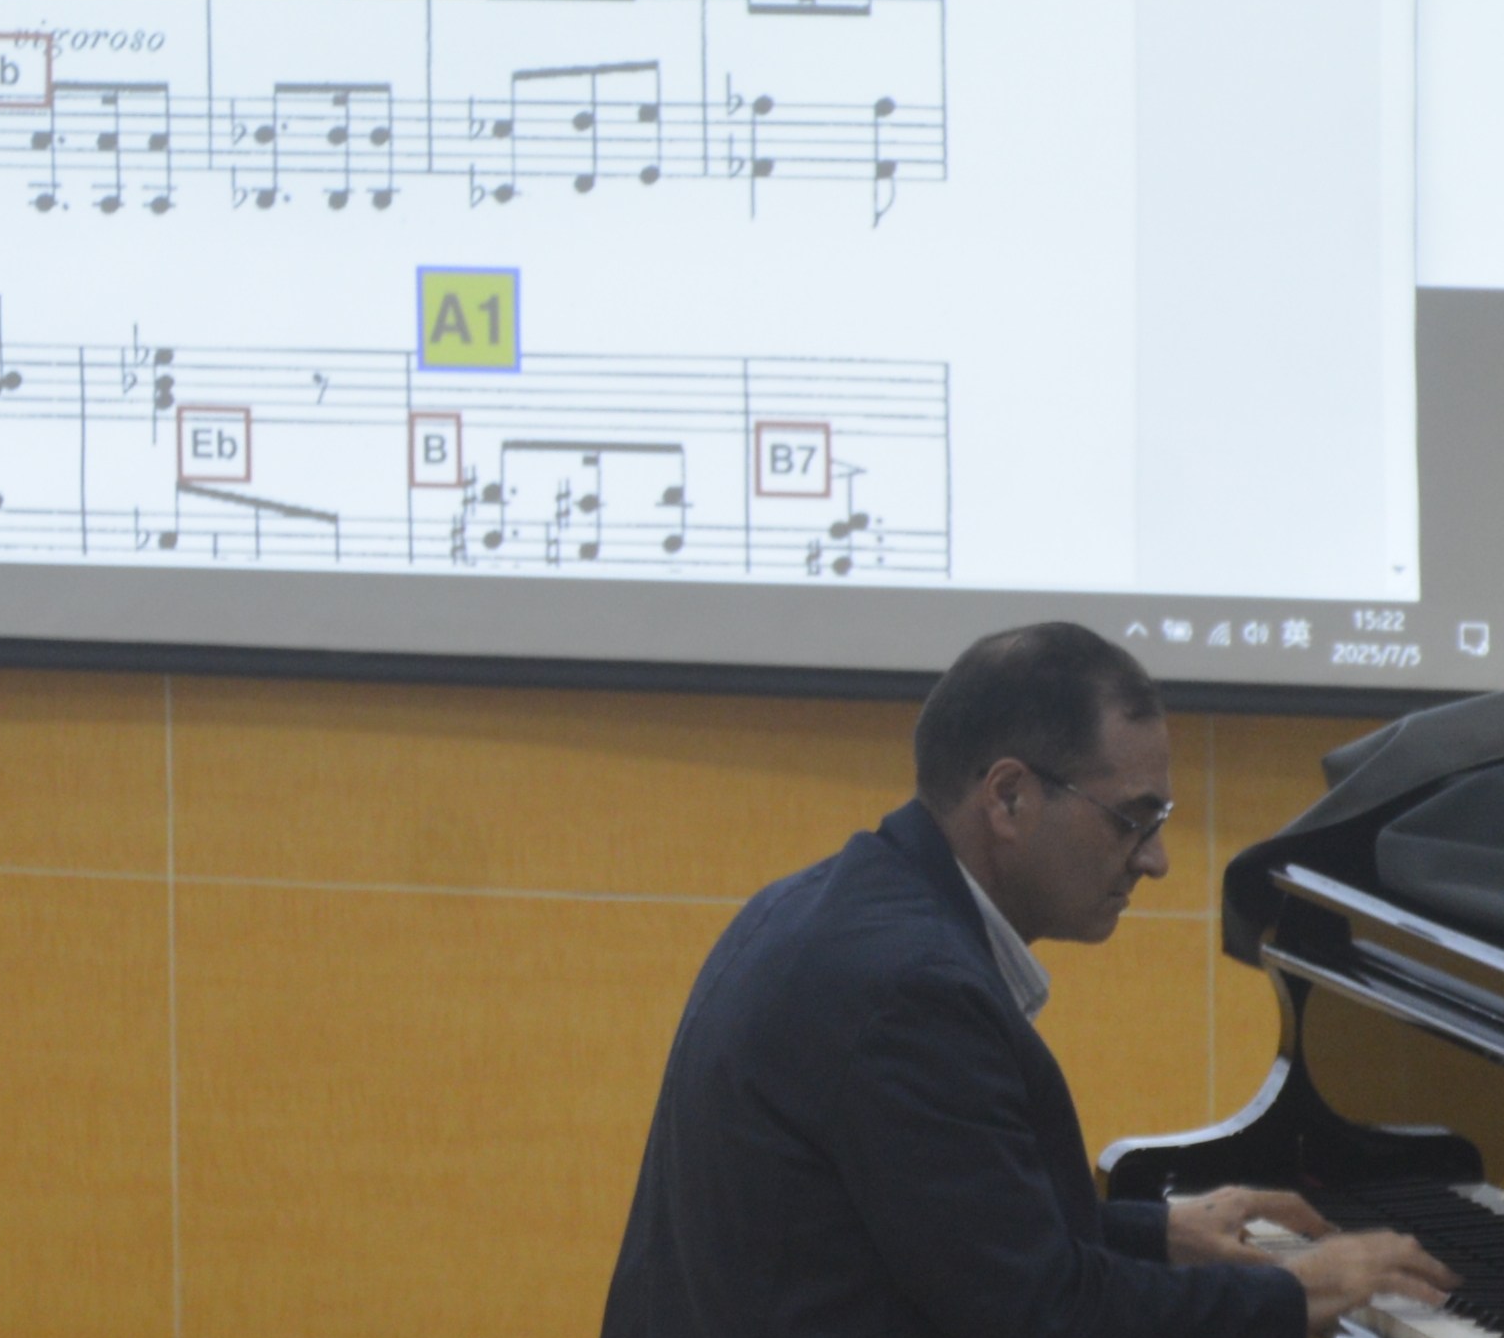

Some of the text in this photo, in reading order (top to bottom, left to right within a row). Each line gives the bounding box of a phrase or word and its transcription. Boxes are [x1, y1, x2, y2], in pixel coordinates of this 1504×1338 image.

[13, 18, 167, 59] vigoroso
[428, 291, 503, 348] A1
[189, 428, 239, 461] Eb
[422, 434, 448, 465] B
[769, 444, 819, 477] B7
[1352, 609, 1406, 632] 15:22
[1330, 642, 1422, 669] 2025/7/5
